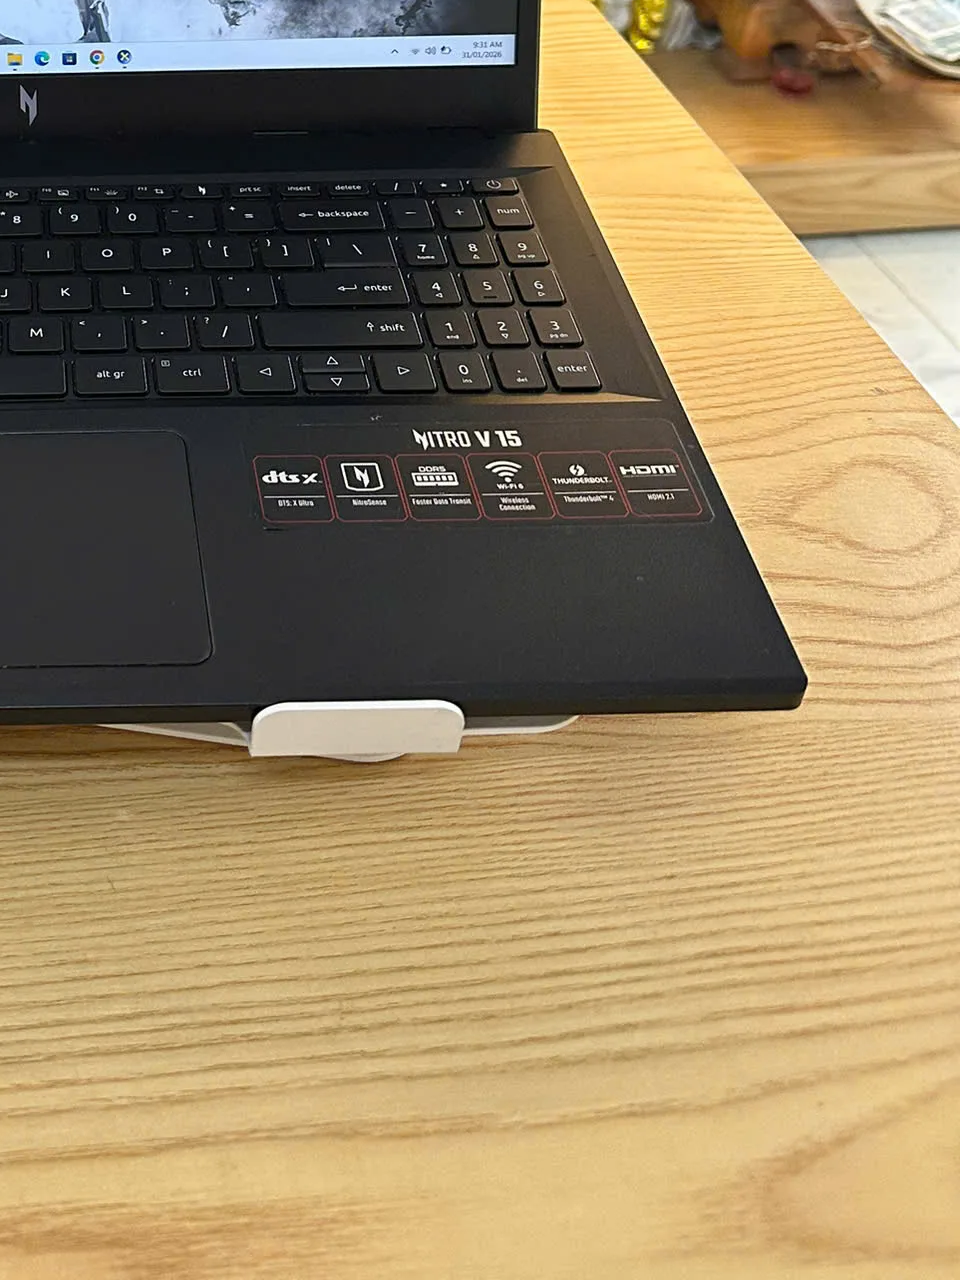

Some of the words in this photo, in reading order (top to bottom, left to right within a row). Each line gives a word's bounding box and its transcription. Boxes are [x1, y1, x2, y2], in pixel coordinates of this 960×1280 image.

[318, 209, 369, 218] backspace
[496, 207, 520, 215] num
[70, 214, 78, 222] 9
[418, 244, 427, 253] 7
[468, 243, 478, 252] 8
[517, 243, 527, 251] 9
[101, 249, 113, 258] O
[162, 248, 171, 256] P
[364, 283, 392, 291] enter
[432, 282, 441, 291] 4
[482, 281, 492, 290] 5
[534, 281, 544, 289] 6
[0, 289, 8, 298] J
[61, 287, 71, 296] K
[123, 286, 131, 295] L
[379, 323, 405, 332] shift
[445, 322, 453, 331] 1
[497, 322, 508, 331] 2
[549, 321, 560, 330] 3
[29, 328, 43, 337] M
[97, 370, 111, 378] alt
[113, 371, 125, 379] gr
[183, 368, 201, 376] ctrl
[412, 429, 471, 451] NITRO
[474, 431, 489, 447] V
[495, 430, 522, 447] 15
